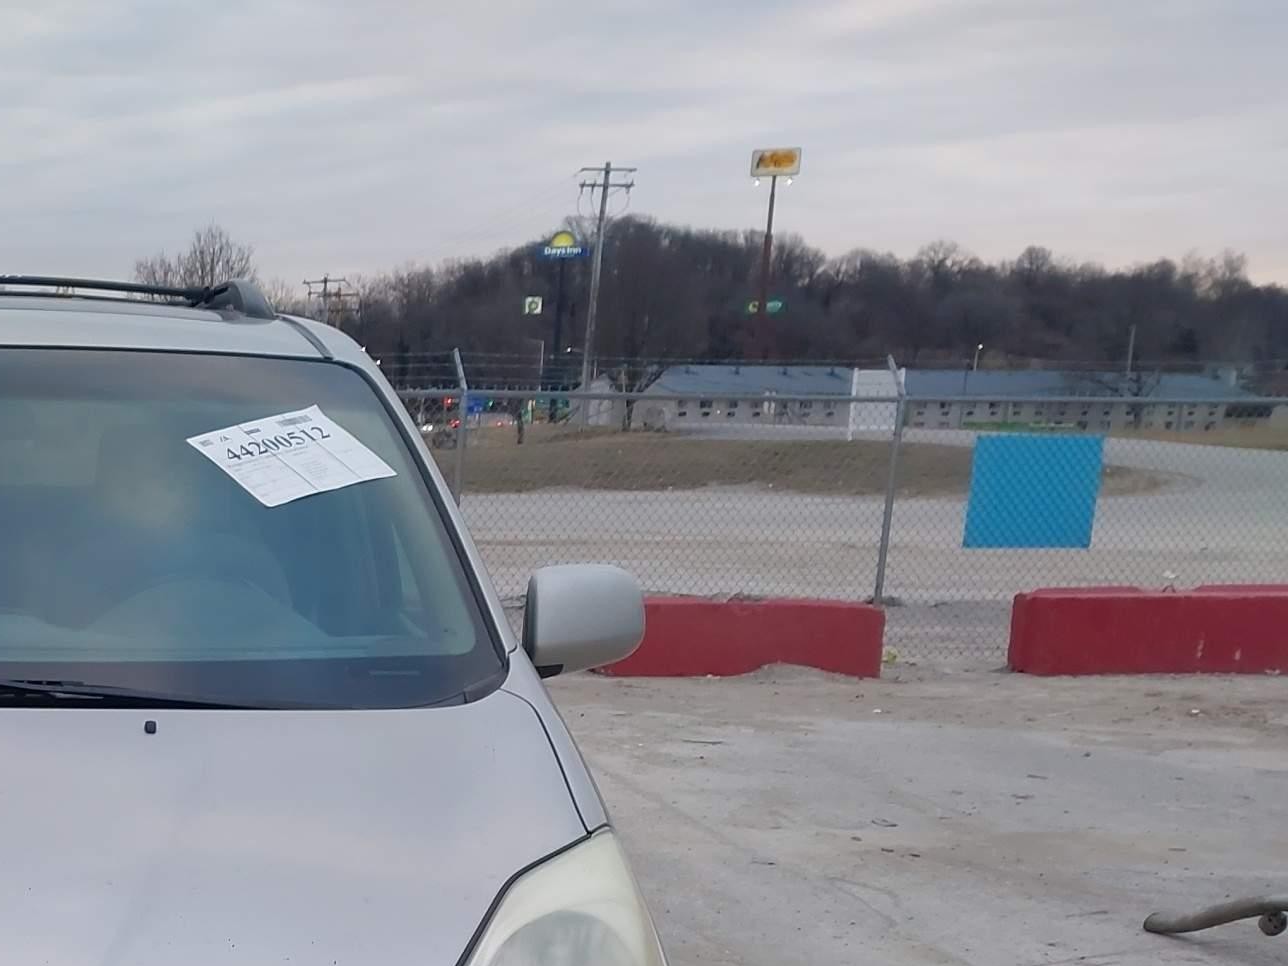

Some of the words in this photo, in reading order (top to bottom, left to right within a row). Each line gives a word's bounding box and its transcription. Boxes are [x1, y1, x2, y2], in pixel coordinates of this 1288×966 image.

[543, 246, 565, 256] Days
[567, 246, 582, 256] Inn
[226, 426, 331, 461] 44200512
